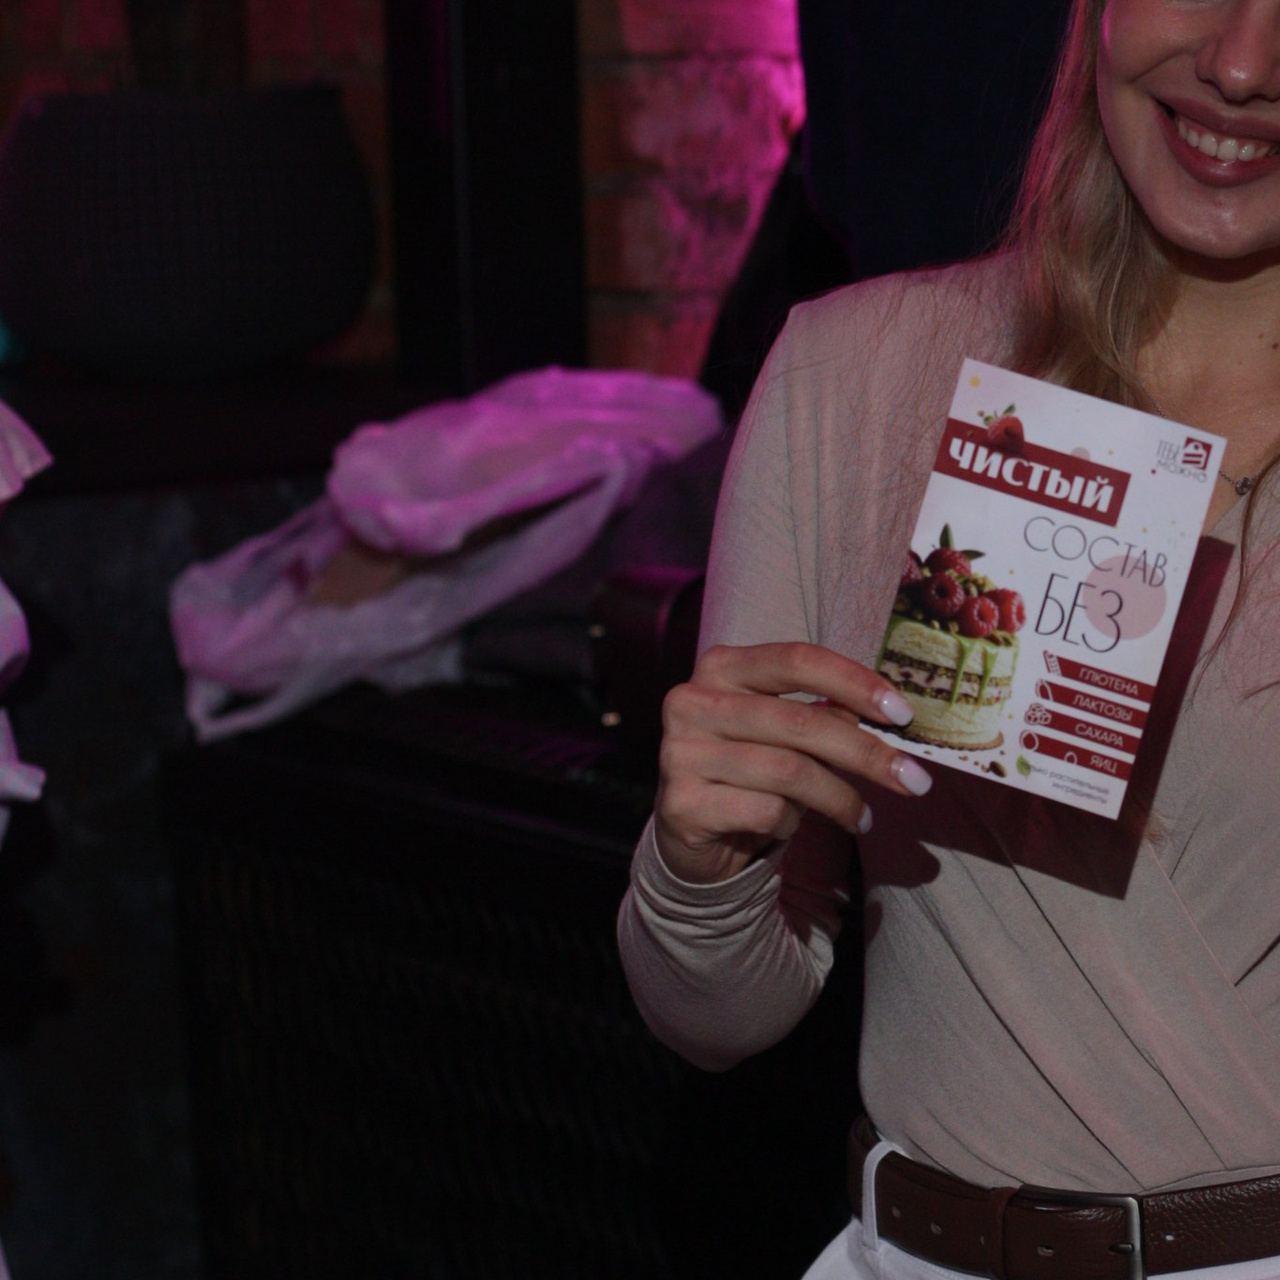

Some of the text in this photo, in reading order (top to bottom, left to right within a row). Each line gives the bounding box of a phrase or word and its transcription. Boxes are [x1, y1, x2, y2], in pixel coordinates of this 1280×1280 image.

[948, 437, 1115, 512] ЧИСТЫЙ
[1024, 516, 1168, 587] СОСТАВ
[1035, 573, 1123, 653] БЕЗ
[1078, 667, 1139, 696] ГЛЮТЕНА
[1072, 694, 1133, 721] ЛАКТОЗЫ
[1075, 723, 1125, 748] САХАРА
[1090, 755, 1118, 774] ЯИЦ
